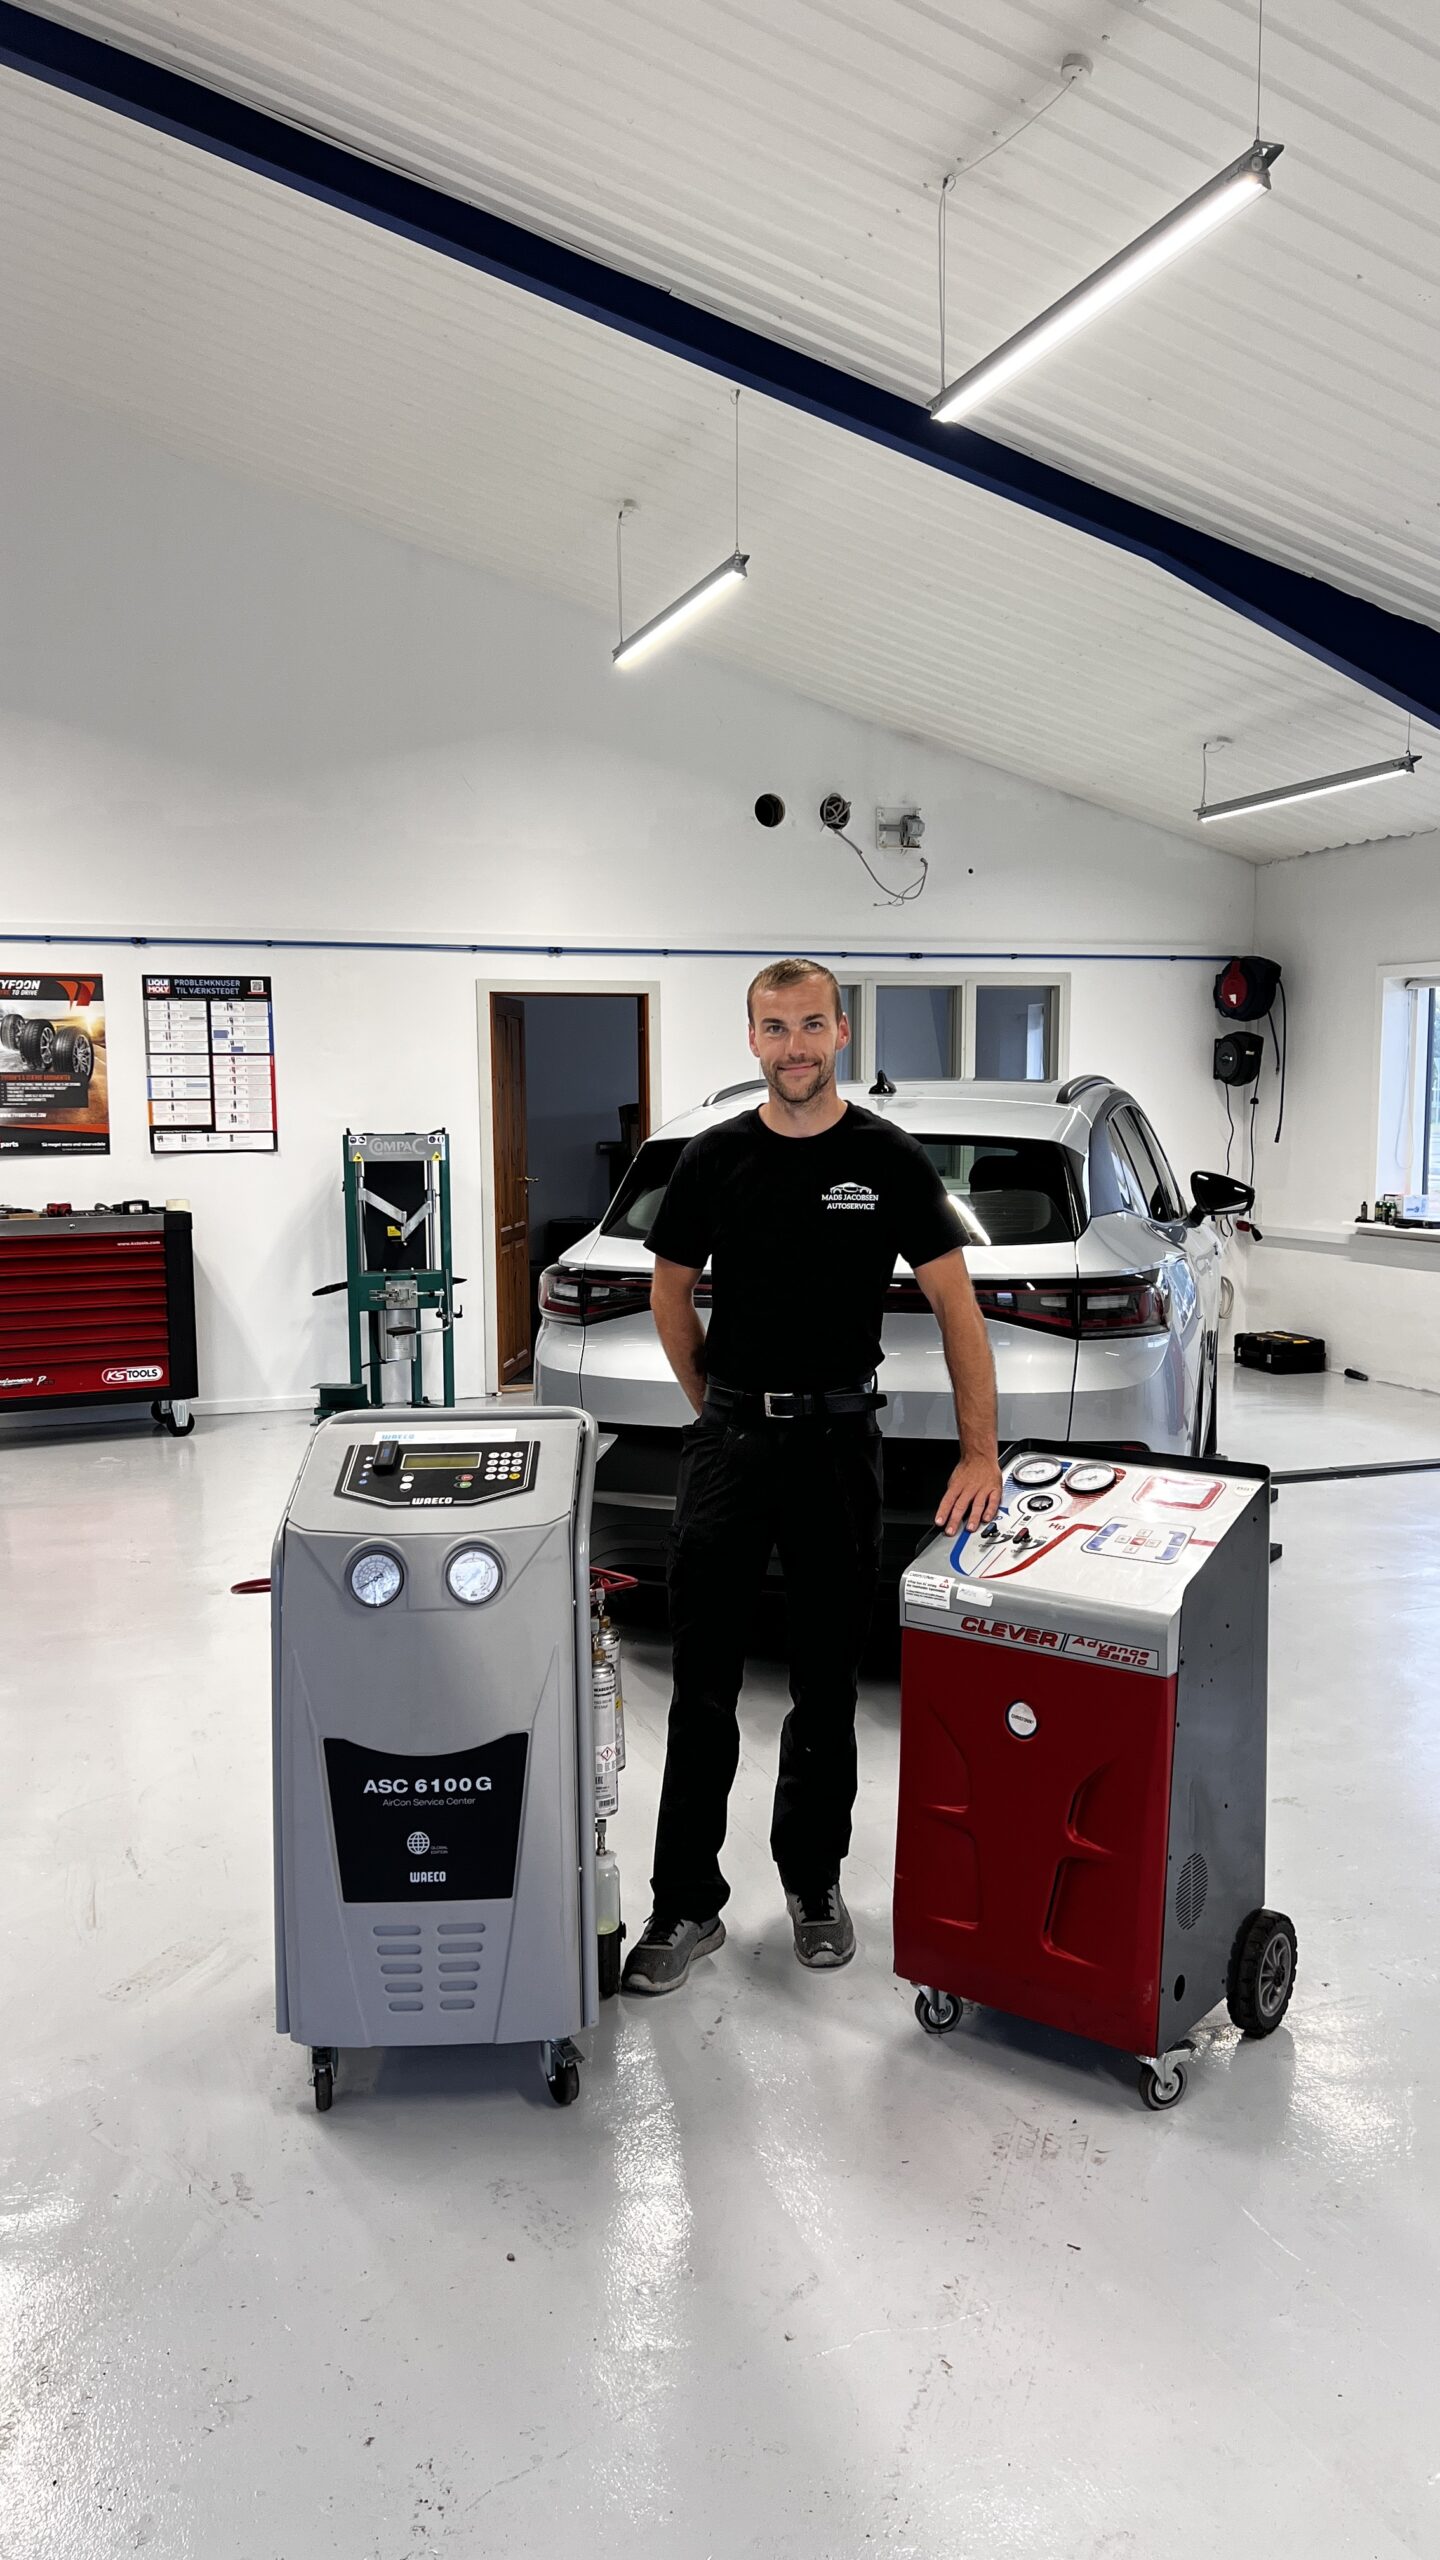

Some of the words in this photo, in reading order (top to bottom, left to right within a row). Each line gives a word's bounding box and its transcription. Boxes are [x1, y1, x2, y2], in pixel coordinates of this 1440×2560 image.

[173, 979, 241, 987] PROBLEMKNUSER
[147, 986, 170, 994] MOLY
[175, 987, 188, 995] TIL
[189, 987, 240, 995] VÆRKSTEDET
[106, 1370, 127, 1381] KS
[127, 1369, 158, 1379] TOOLS
[411, 1497, 453, 1505] WAECO
[960, 1616, 1059, 1647] CLEVER
[1072, 1636, 1150, 1660] Advance
[362, 1778, 409, 1794] ASC
[382, 1798, 412, 1807] AirCon
[412, 1798, 445, 1806] Service
[445, 1796, 476, 1806] Center
[409, 1871, 447, 1883] WAECO
